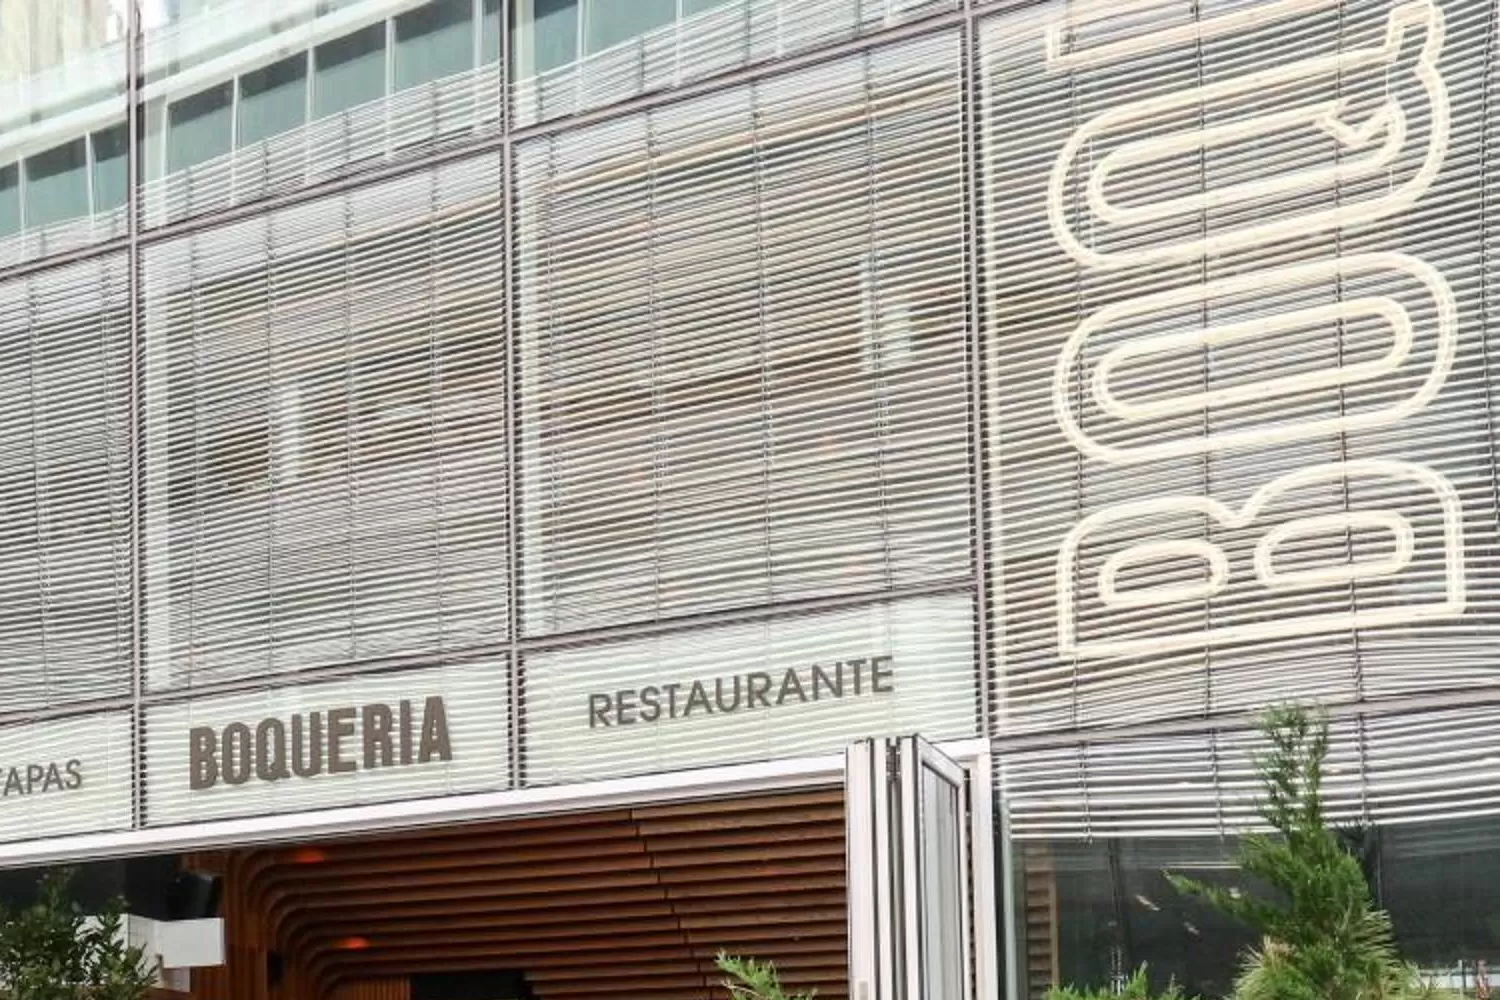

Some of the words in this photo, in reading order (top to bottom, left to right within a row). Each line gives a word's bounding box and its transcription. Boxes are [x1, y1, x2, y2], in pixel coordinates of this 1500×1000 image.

[1045, 0, 1466, 657] BOQ
[588, 655, 894, 728] RESTAURANTE
[189, 695, 452, 790] BOQUERIA
